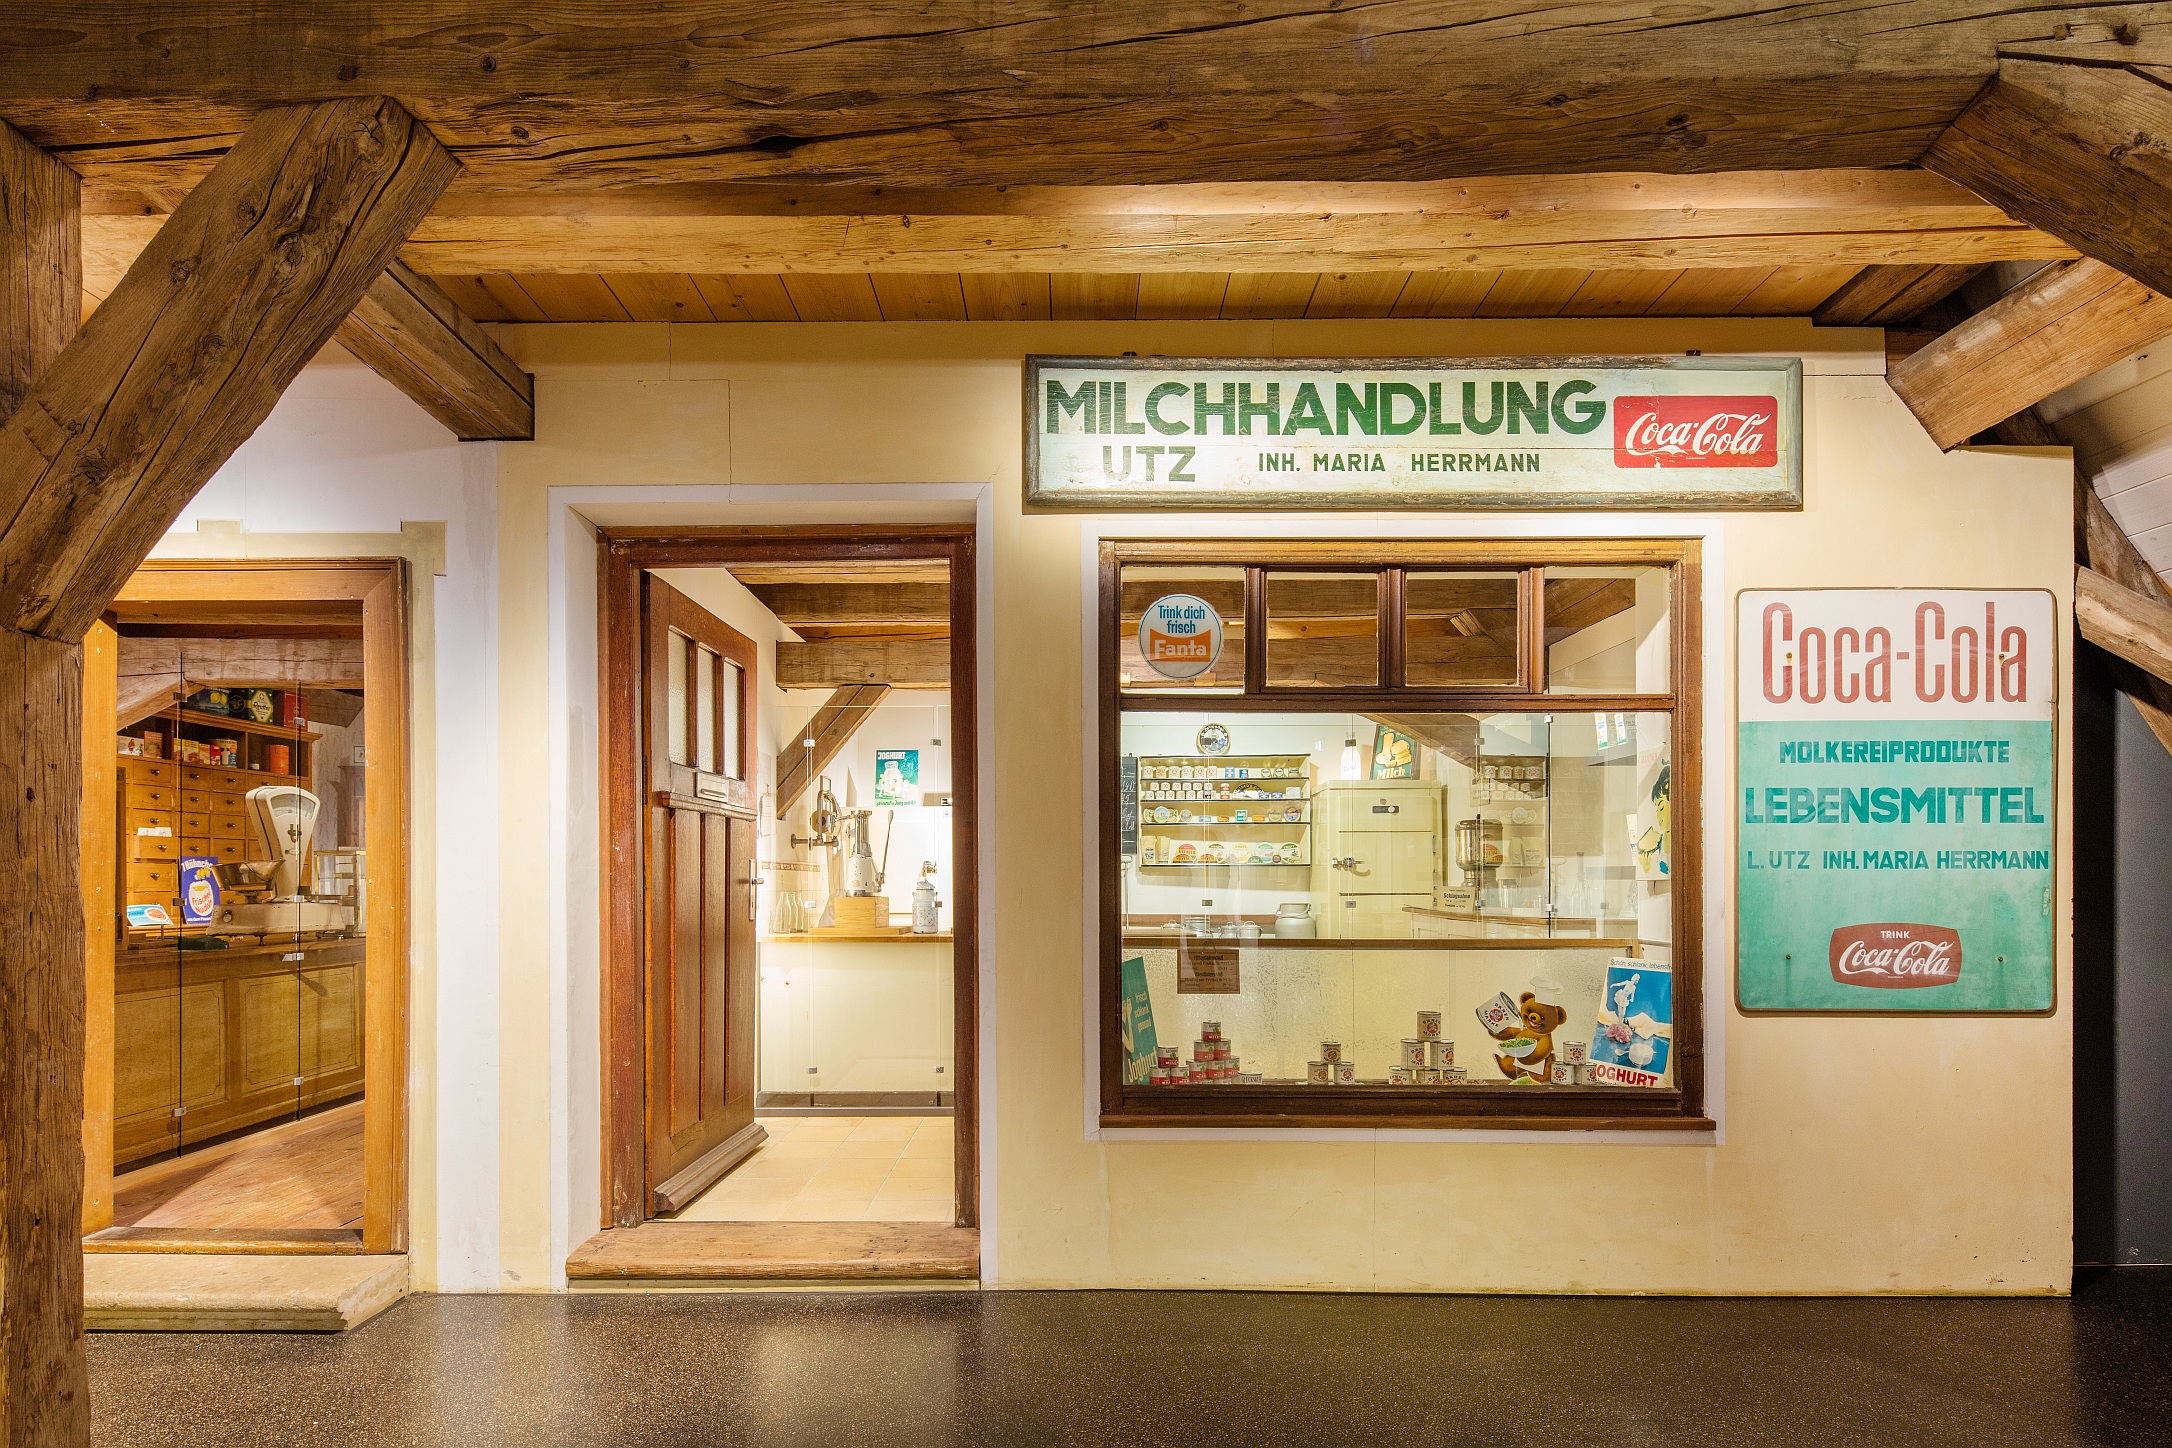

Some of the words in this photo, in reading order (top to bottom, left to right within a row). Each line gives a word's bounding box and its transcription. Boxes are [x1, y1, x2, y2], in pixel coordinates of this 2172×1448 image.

[1047, 380, 1607, 436] MILCHHANDLUNG
[1625, 412, 1771, 457] Coca-Cola
[1102, 446, 1196, 482] UTZ
[1258, 452, 1301, 472] INH.
[1313, 453, 1386, 472] MARIA
[1411, 453, 1540, 472] HERRMANN
[1158, 605, 1182, 619] Trink
[1184, 605, 1205, 619] dich
[1167, 619, 1196, 634] frisch
[1154, 639, 1207, 659] Fanta
[1762, 601, 2028, 704] Coca-Cola
[1779, 741, 2010, 763] MOLKEREIPRODUKTE
[1377, 767, 1406, 779] Milch
[1745, 786, 2045, 824] LEBENSMITTEL
[1747, 851, 1765, 870] L.
[1769, 851, 1810, 870] UTZ
[1823, 851, 1860, 870] INH.
[1863, 851, 1929, 870] MARIA
[1936, 851, 2050, 870] HERRMANN
[1880, 930, 1910, 939] TRINK
[1838, 940, 1955, 977] Coca-Cola
[1128, 1046, 1158, 1083] Joghurt
[1596, 1064, 1658, 1088] OGHURT
